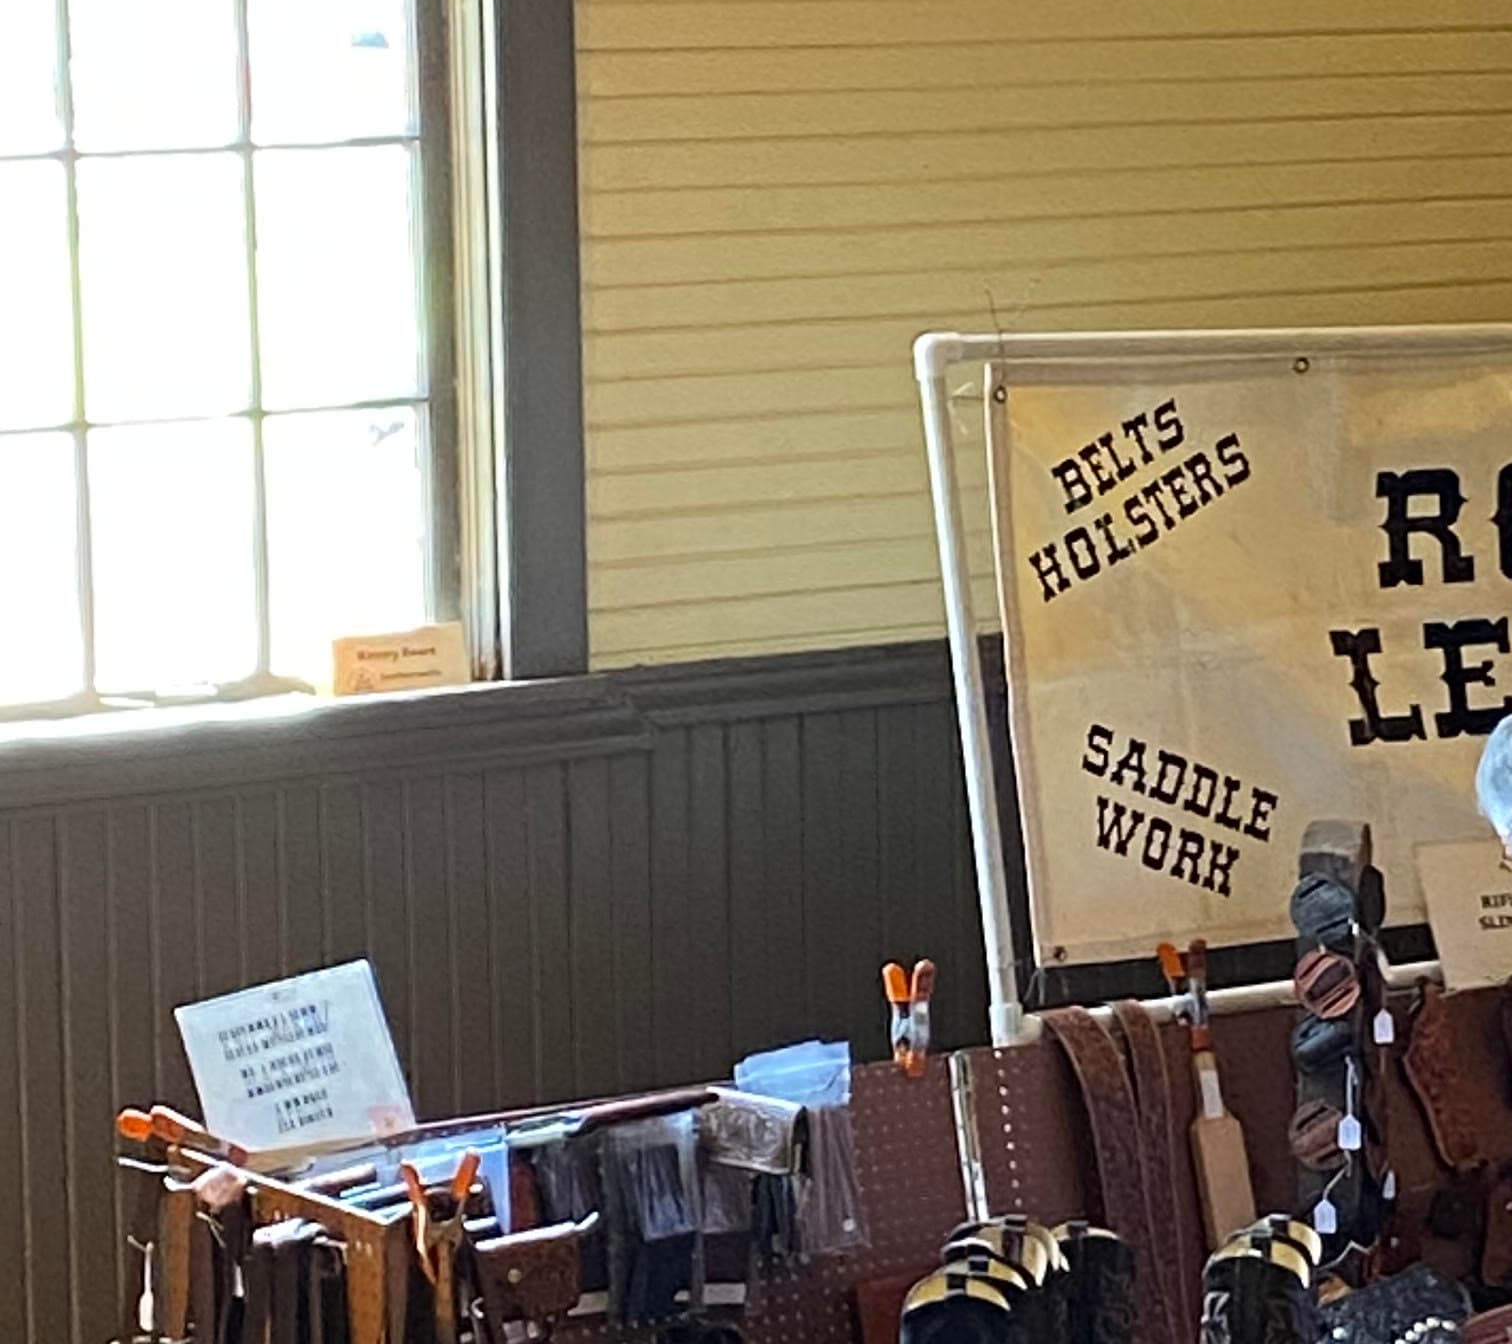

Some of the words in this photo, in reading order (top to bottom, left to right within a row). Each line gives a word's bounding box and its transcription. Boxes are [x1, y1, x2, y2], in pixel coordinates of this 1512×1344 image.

[1051, 397, 1185, 515] BELTS
[1028, 432, 1252, 603] HOLSTERS
[1082, 724, 1279, 843] SADDLE
[1096, 795, 1241, 898] WORK
